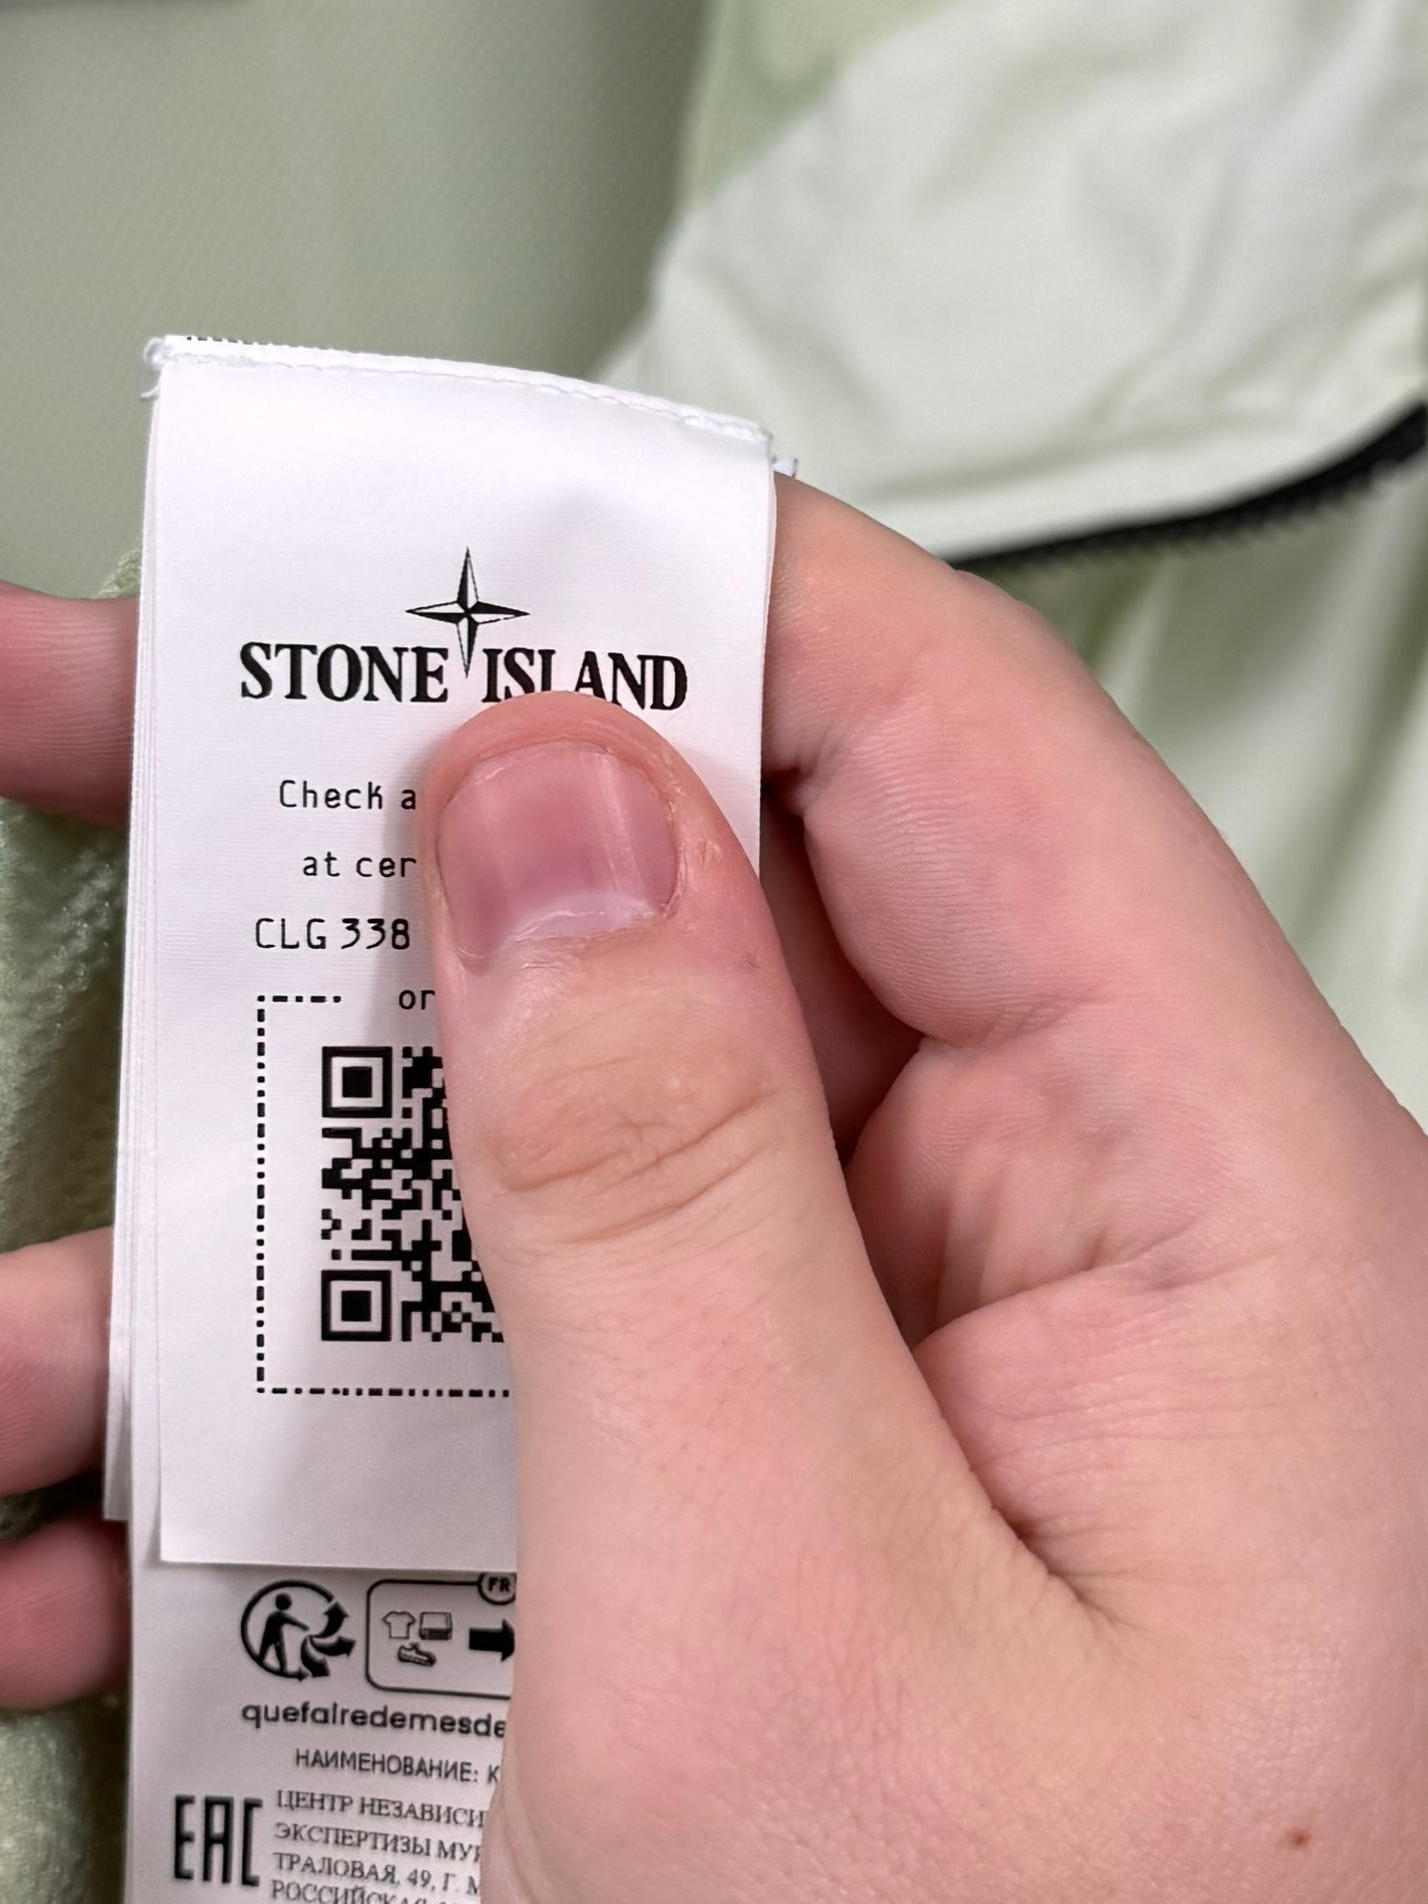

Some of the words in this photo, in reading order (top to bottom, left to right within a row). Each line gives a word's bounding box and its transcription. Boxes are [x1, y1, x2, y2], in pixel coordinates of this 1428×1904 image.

[239, 641, 449, 703] STONE
[481, 646, 688, 711] ISLAND
[279, 779, 383, 810] Check
[303, 851, 340, 877] at
[356, 857, 417, 878] cer
[255, 918, 326, 950] CLG
[341, 918, 410, 951] 338
[398, 989, 436, 1010] or
[488, 1576, 511, 1593] FR
[295, 1748, 479, 1783] НАИМЕНОВАНИЕ:
[277, 1790, 354, 1813] ЦЕНТР
[275, 1822, 430, 1858] ЭКСПЕРТИЗЫ
[273, 1852, 400, 1886] ТРАЛОВАЯ,
